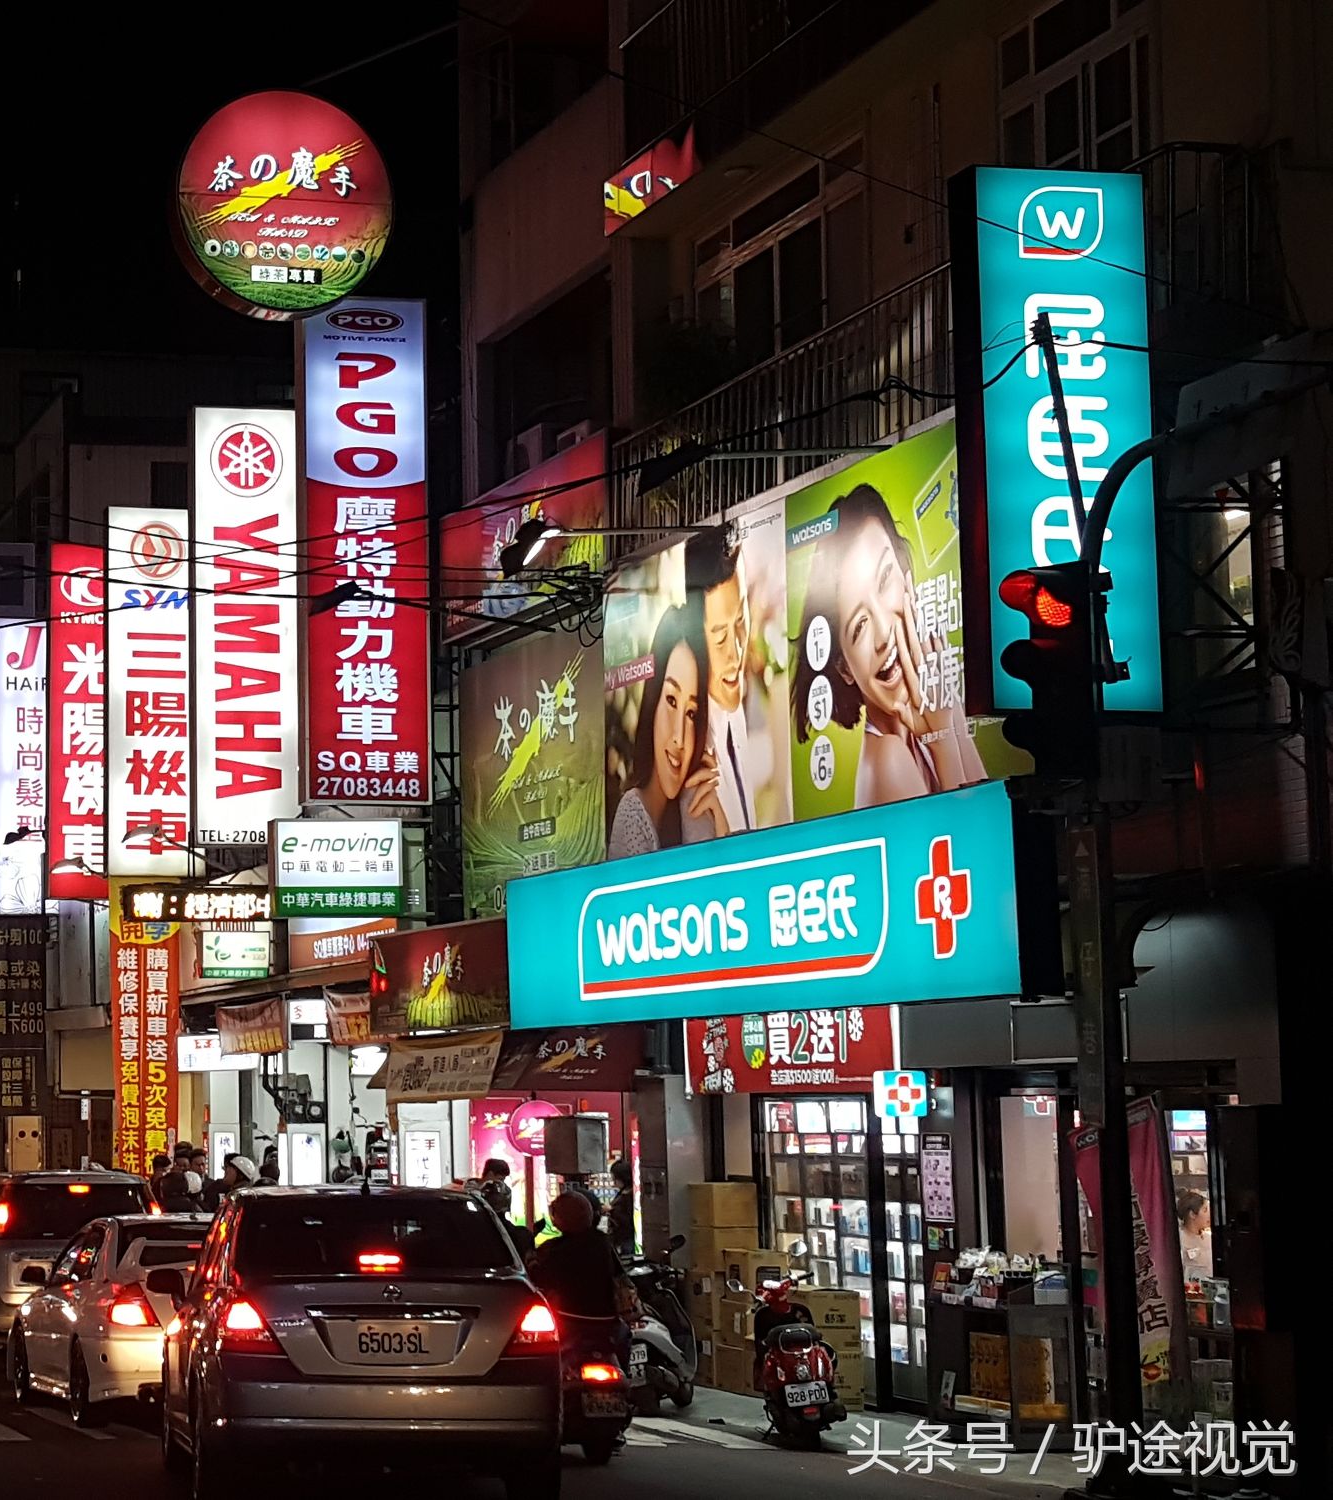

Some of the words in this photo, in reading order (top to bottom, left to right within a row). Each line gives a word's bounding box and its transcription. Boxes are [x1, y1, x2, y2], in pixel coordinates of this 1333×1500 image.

[207, 146, 357, 198] 茶の魔手
[337, 315, 394, 327] PGO
[334, 352, 398, 478] PGO
[792, 515, 834, 546] watsons
[61, 611, 104, 625] KYMC
[333, 496, 400, 745] 摩特動力機車
[916, 571, 963, 643] 積點
[213, 513, 283, 800] YAMAHA
[918, 645, 965, 716] 好康
[126, 631, 188, 856] 三陽機車
[493, 672, 579, 762] 茶の魔手
[16, 706, 45, 843] 時尚髮型
[61, 642, 105, 878] 光陽機車
[317, 751, 419, 774] SQ車業
[317, 776, 420, 798] 27083448
[281, 832, 395, 858] e-moving
[281, 859, 396, 875] 中華電動二輪車
[596, 896, 750, 968] watsons
[768, 873, 860, 949] 屈臣氏
[535, 1036, 608, 1062] 茶の魔手
